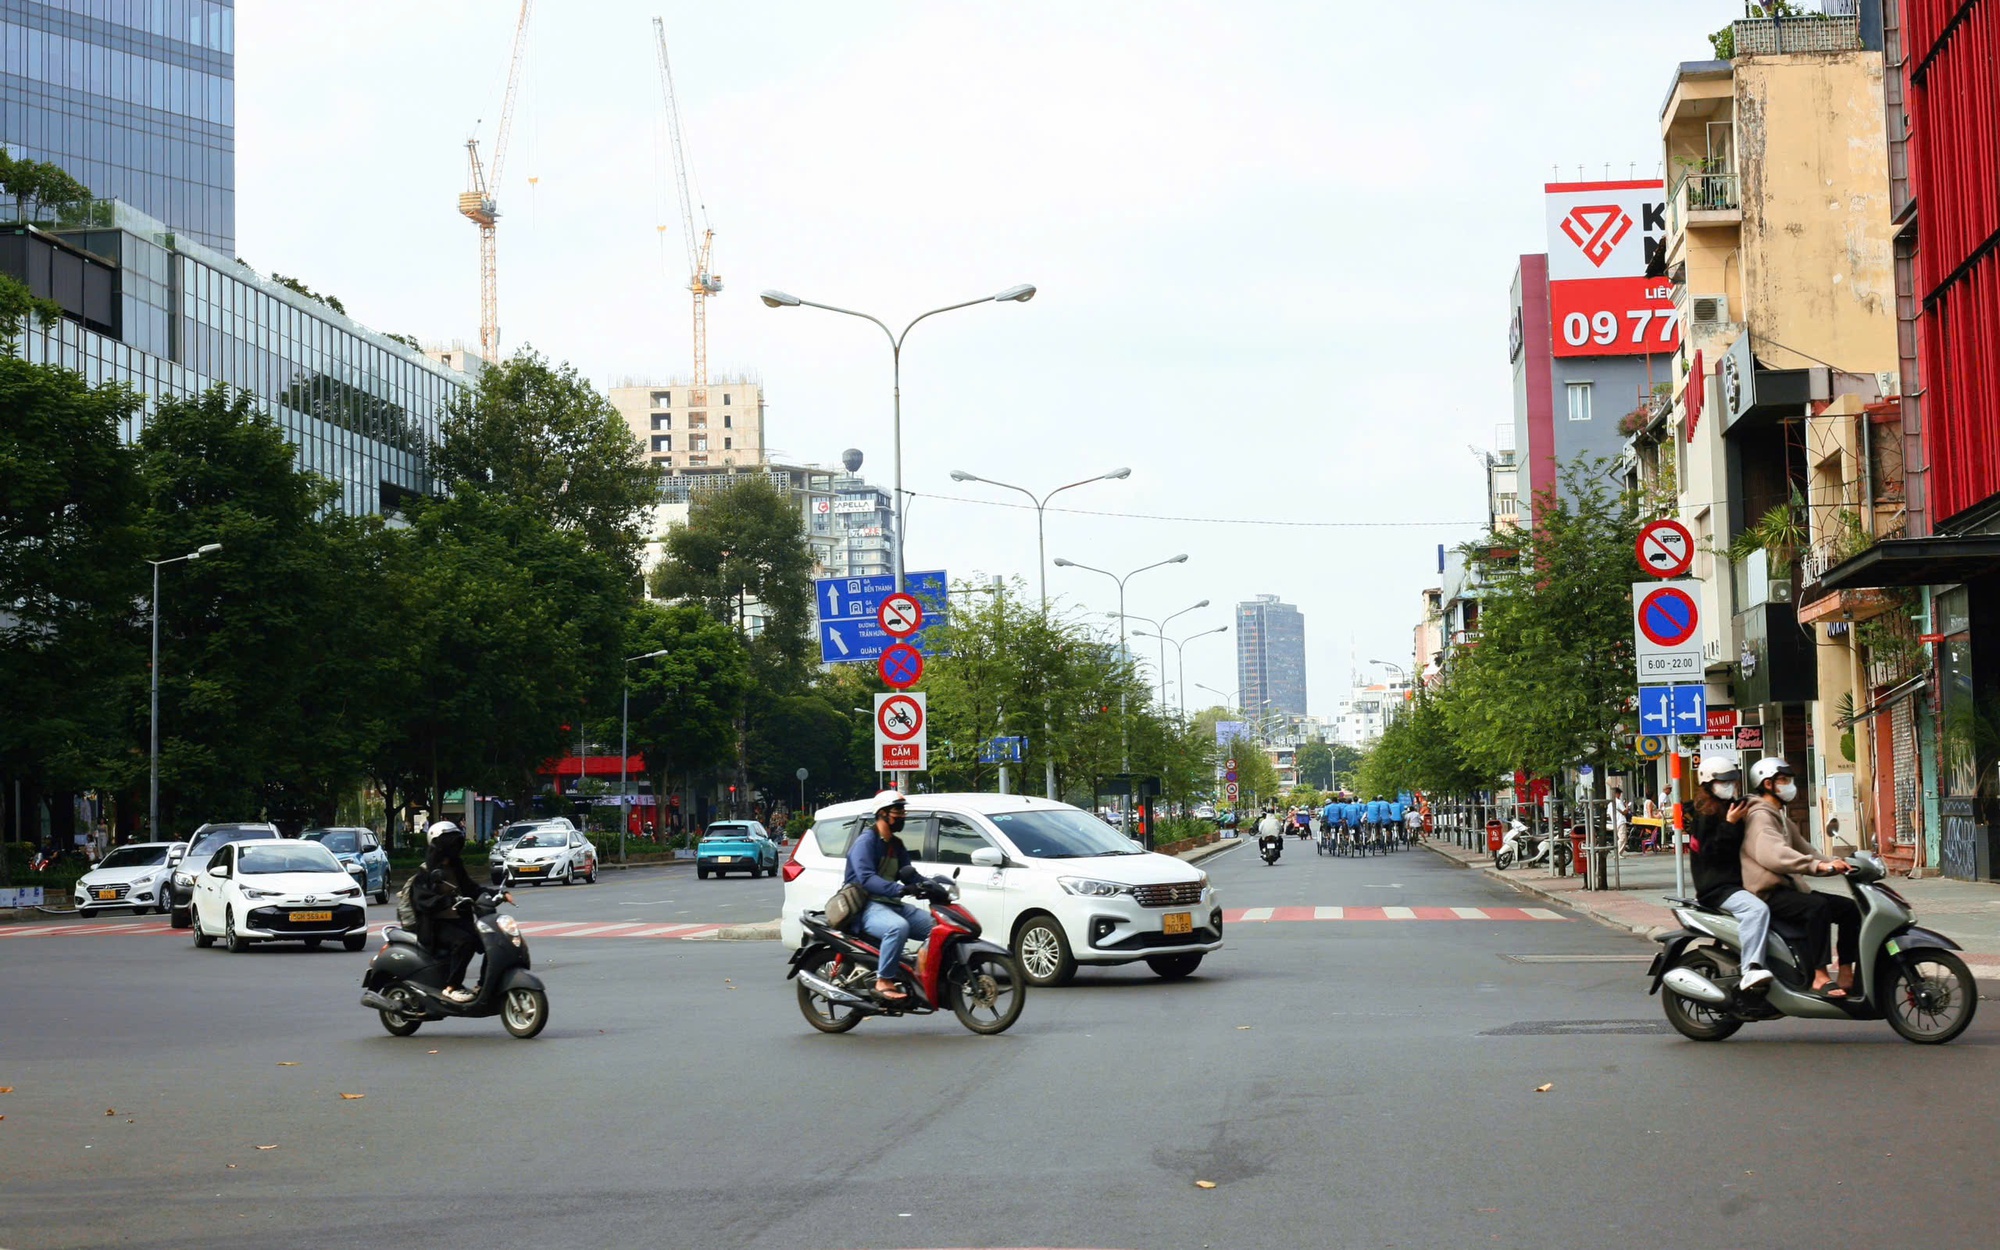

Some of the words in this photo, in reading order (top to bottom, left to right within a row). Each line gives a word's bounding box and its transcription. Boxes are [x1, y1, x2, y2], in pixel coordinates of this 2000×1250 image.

[1563, 310, 1619, 347] 09
[1738, 727, 1759, 739] Spa
[891, 744, 911, 757] CẤM
